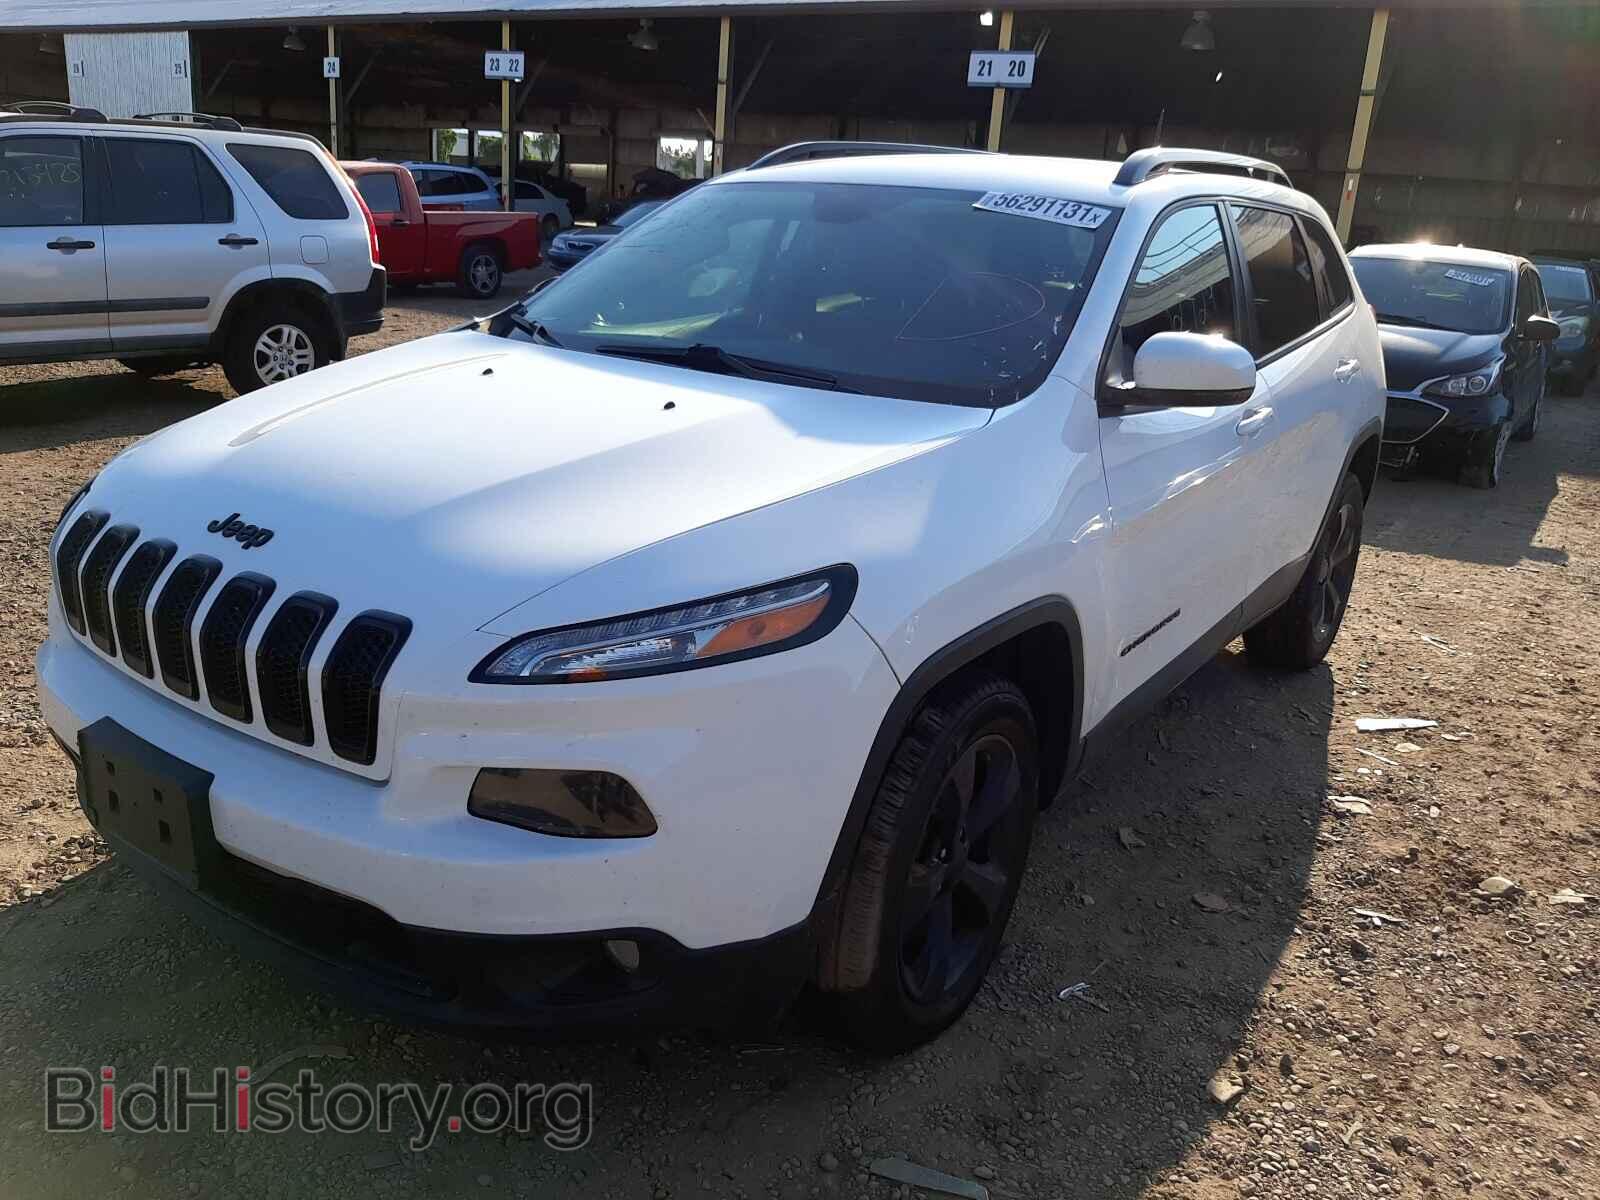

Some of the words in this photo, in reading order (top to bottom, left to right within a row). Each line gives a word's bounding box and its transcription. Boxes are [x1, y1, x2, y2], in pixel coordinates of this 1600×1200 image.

[327, 61, 336, 74] 24
[489, 57, 500, 72] 23
[508, 58, 520, 73] 22
[976, 59, 993, 77] 21
[1007, 59, 1026, 77] 20
[207, 512, 275, 550] Jeep
